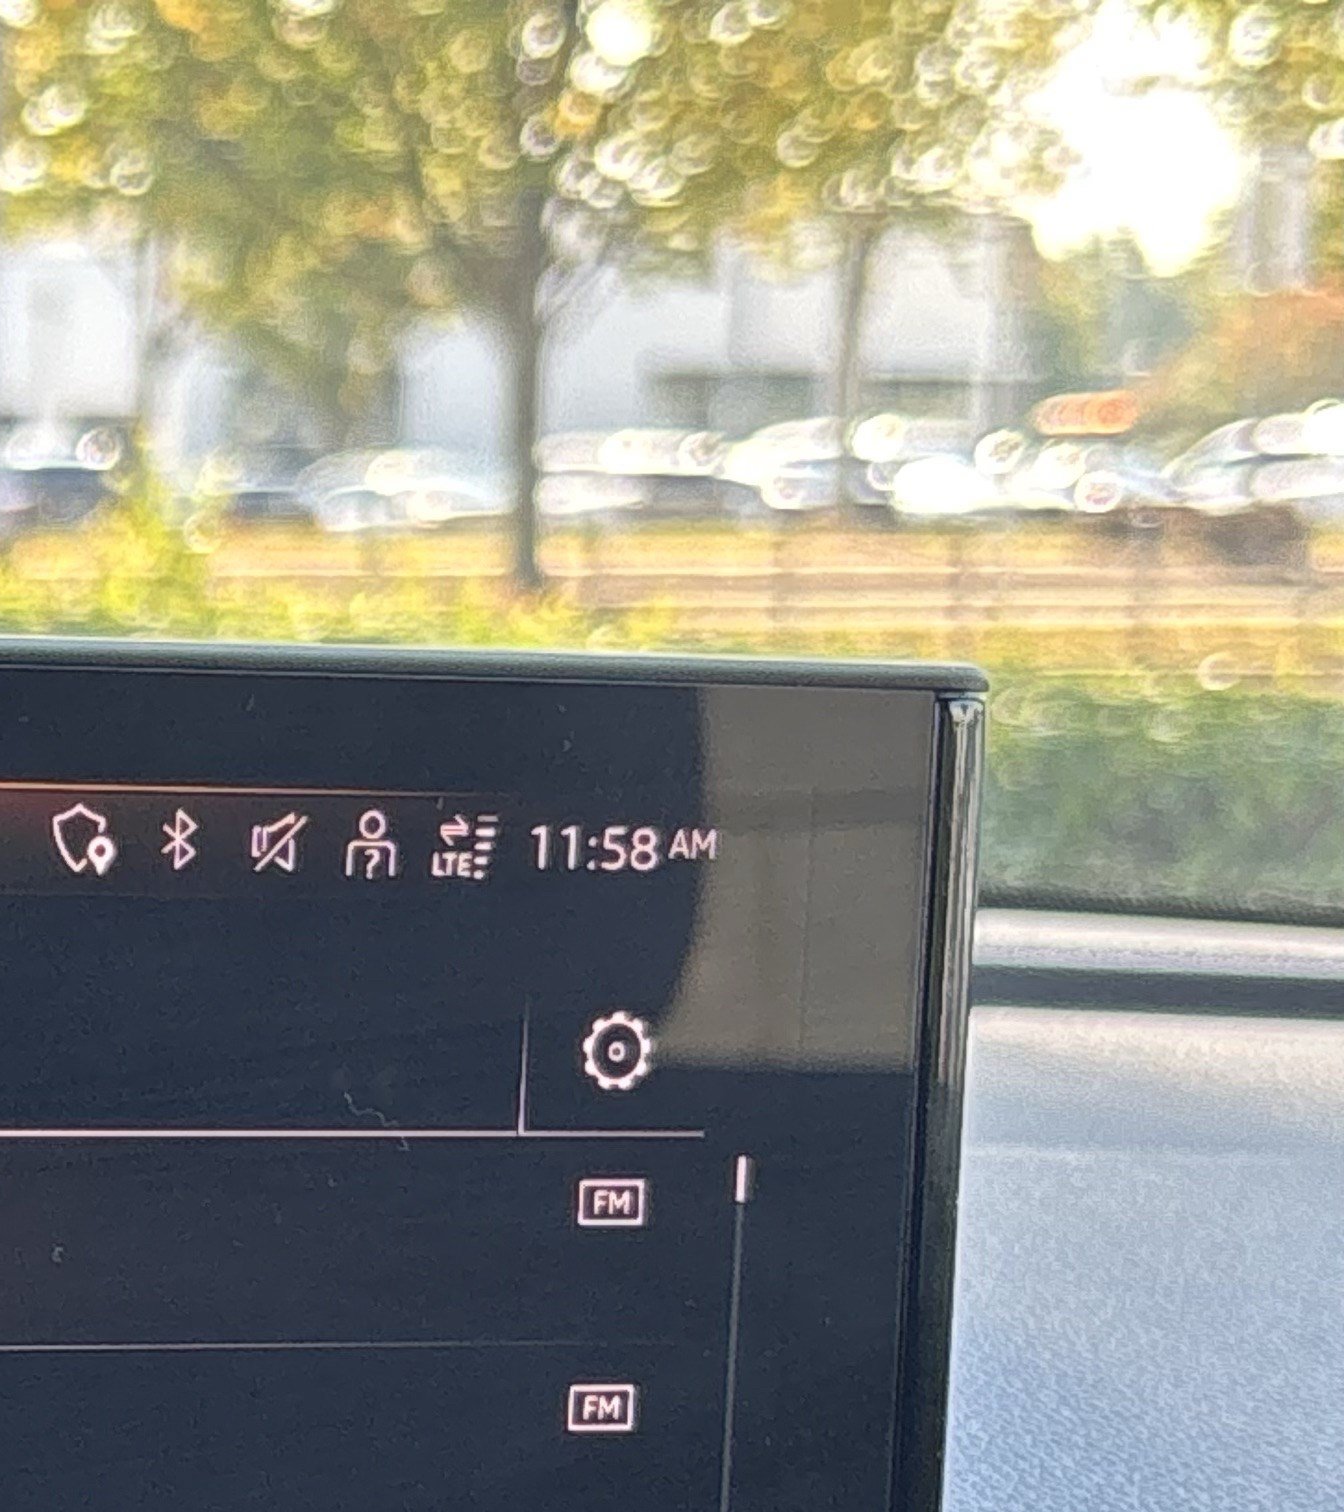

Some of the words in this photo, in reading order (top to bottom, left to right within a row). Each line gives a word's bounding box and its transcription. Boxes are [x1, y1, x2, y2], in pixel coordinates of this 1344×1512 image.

[531, 825, 659, 871] 11:58
[669, 828, 717, 860] AM
[431, 851, 472, 878] LTE
[592, 1189, 632, 1216] FM
[581, 1394, 620, 1421] FM
